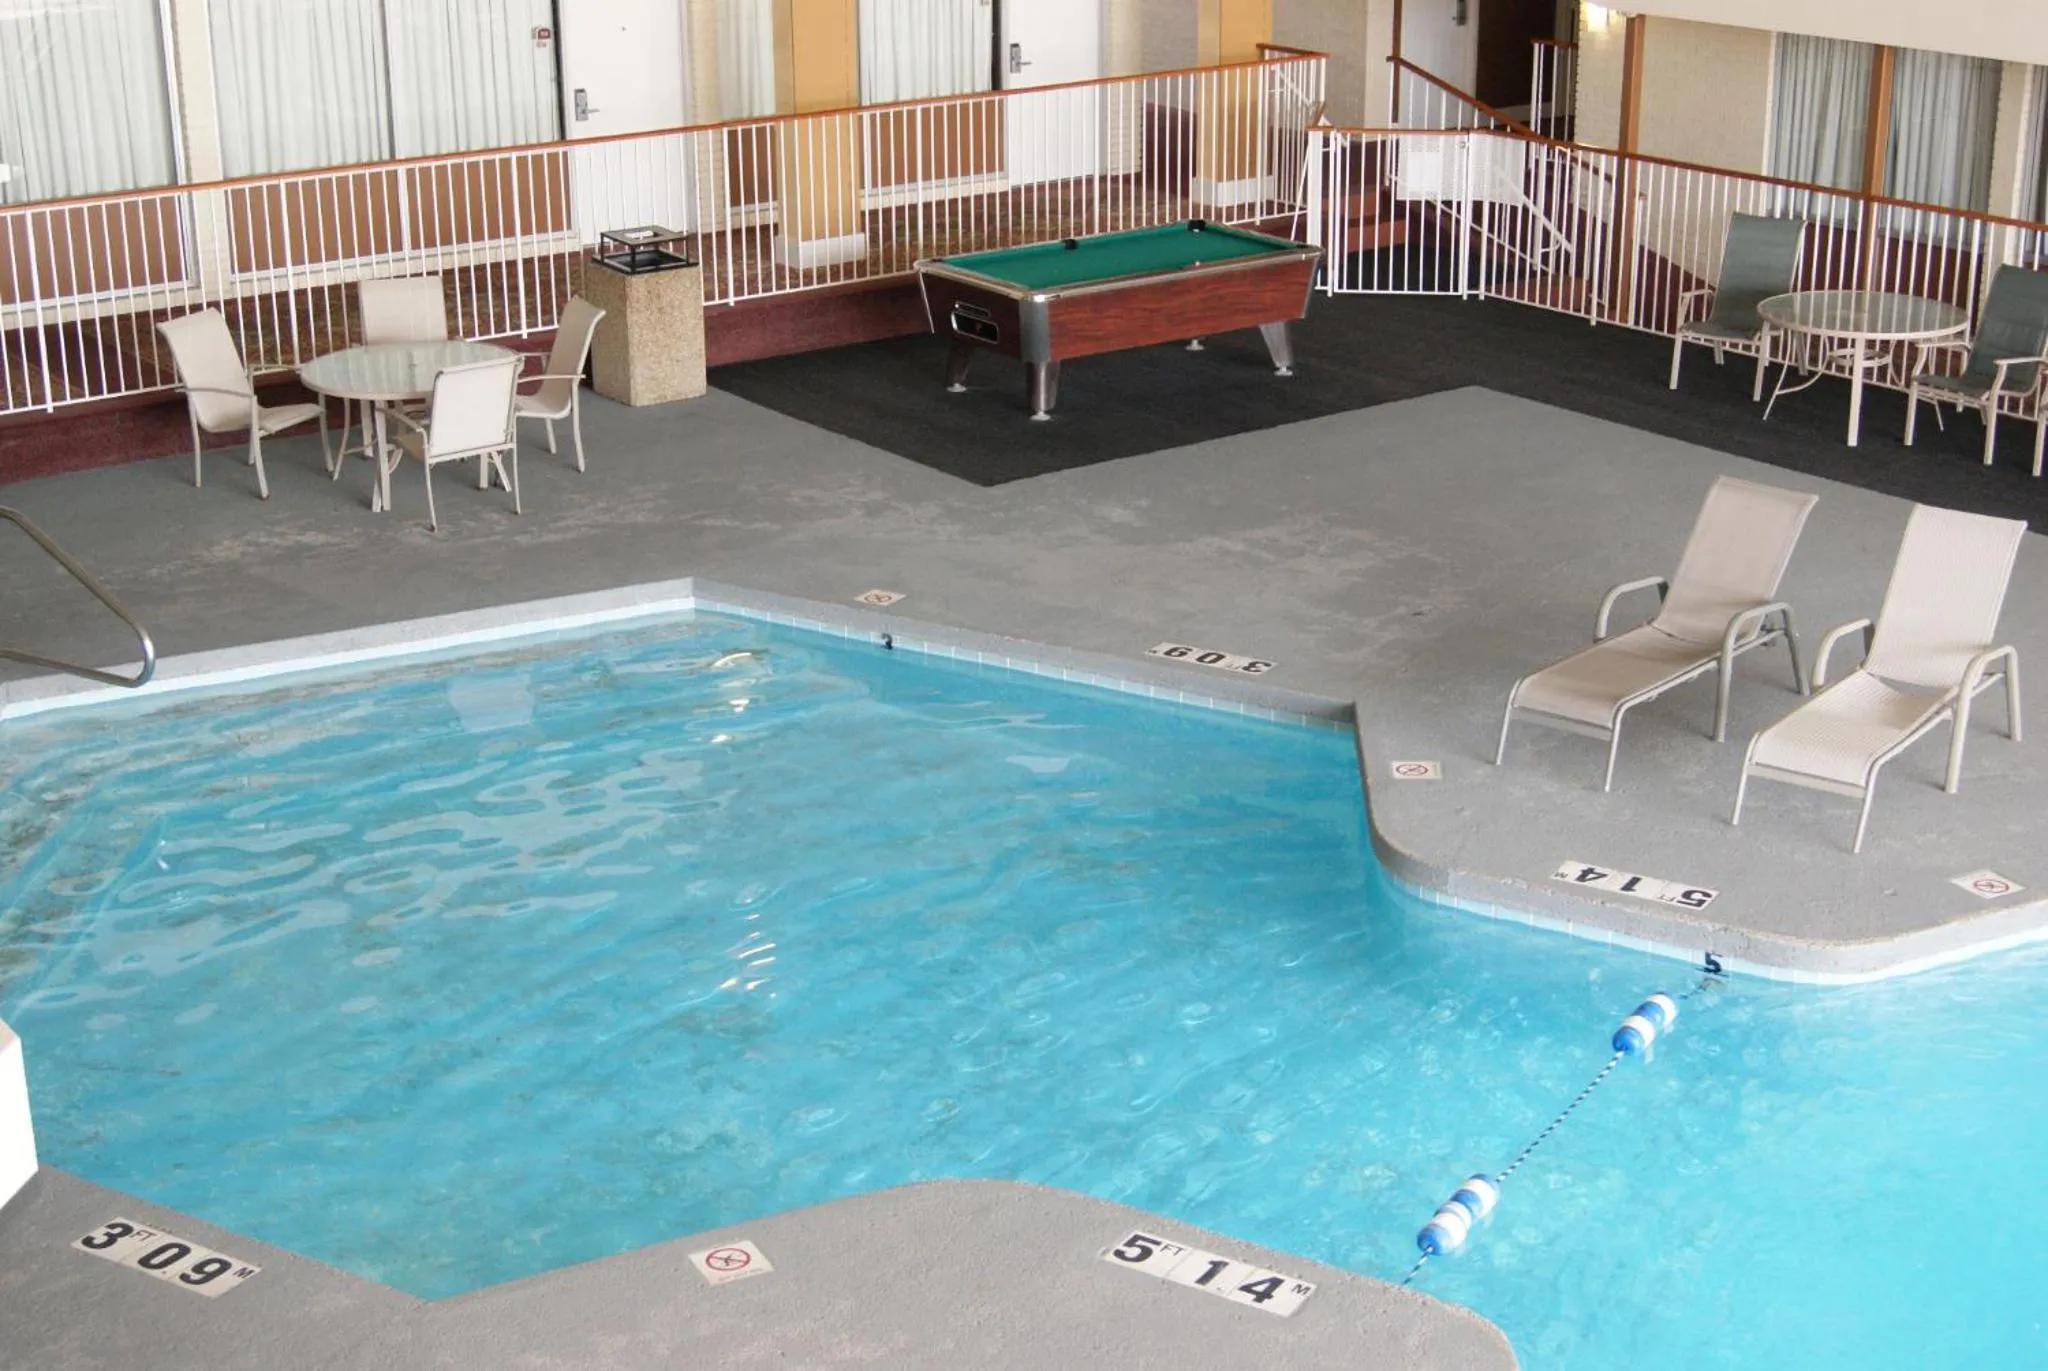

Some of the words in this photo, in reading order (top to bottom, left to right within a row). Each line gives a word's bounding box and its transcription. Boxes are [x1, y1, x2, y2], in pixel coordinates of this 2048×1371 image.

[1242, 660, 1272, 673] 3
[1657, 895, 1676, 903] FT
[1676, 889, 1713, 908] 5
[1704, 951, 1725, 973] 5
[81, 1222, 134, 1249] 3
[129, 1229, 157, 1241] FT
[232, 1266, 256, 1279] M
[1112, 1233, 1163, 1263] 5
[1160, 1244, 1185, 1256] FT
[1291, 1284, 1311, 1296] M
